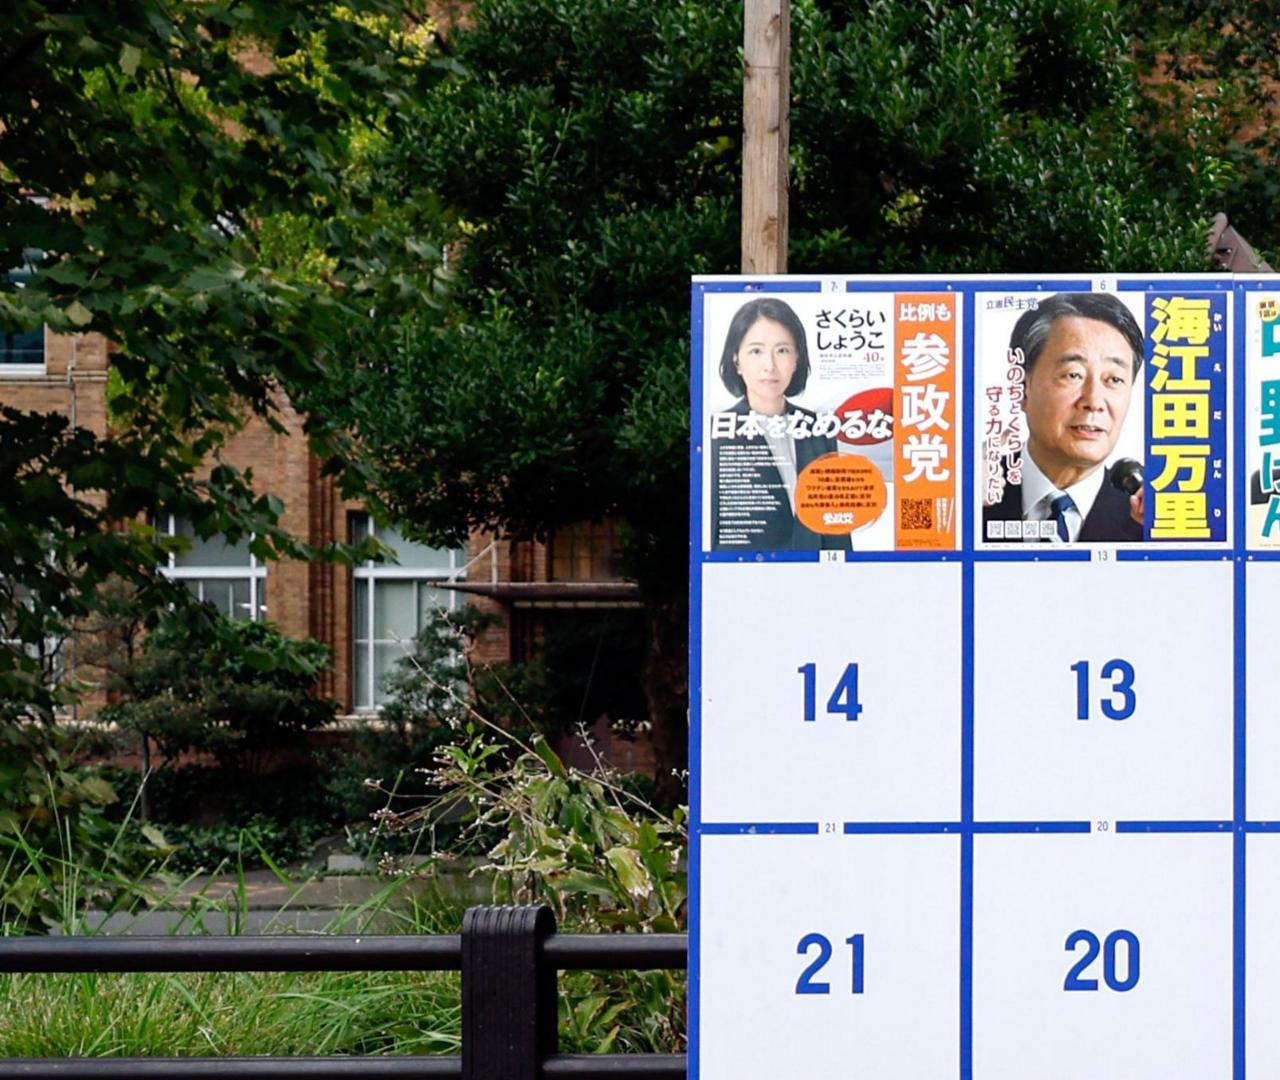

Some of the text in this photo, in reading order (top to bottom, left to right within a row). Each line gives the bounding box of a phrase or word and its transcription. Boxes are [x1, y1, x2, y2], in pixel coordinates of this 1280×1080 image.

[898, 304, 951, 323] 比例も
[1100, 280, 1106, 291] 6
[815, 308, 886, 329] さくらい
[816, 330, 885, 351] しょうこ
[711, 410, 894, 440] 日本をなめるな
[900, 332, 950, 482] 参政党
[1006, 347, 1025, 485] いのちとくらしを
[1150, 296, 1211, 539] 海江田万里
[985, 385, 1003, 504] 守る力になりたい
[1097, 550, 1108, 561] 13
[800, 663, 863, 721] 14
[1071, 659, 1137, 721] 13
[1097, 821, 1109, 832] 20
[795, 932, 865, 994] 21
[1063, 929, 1141, 992] 20
